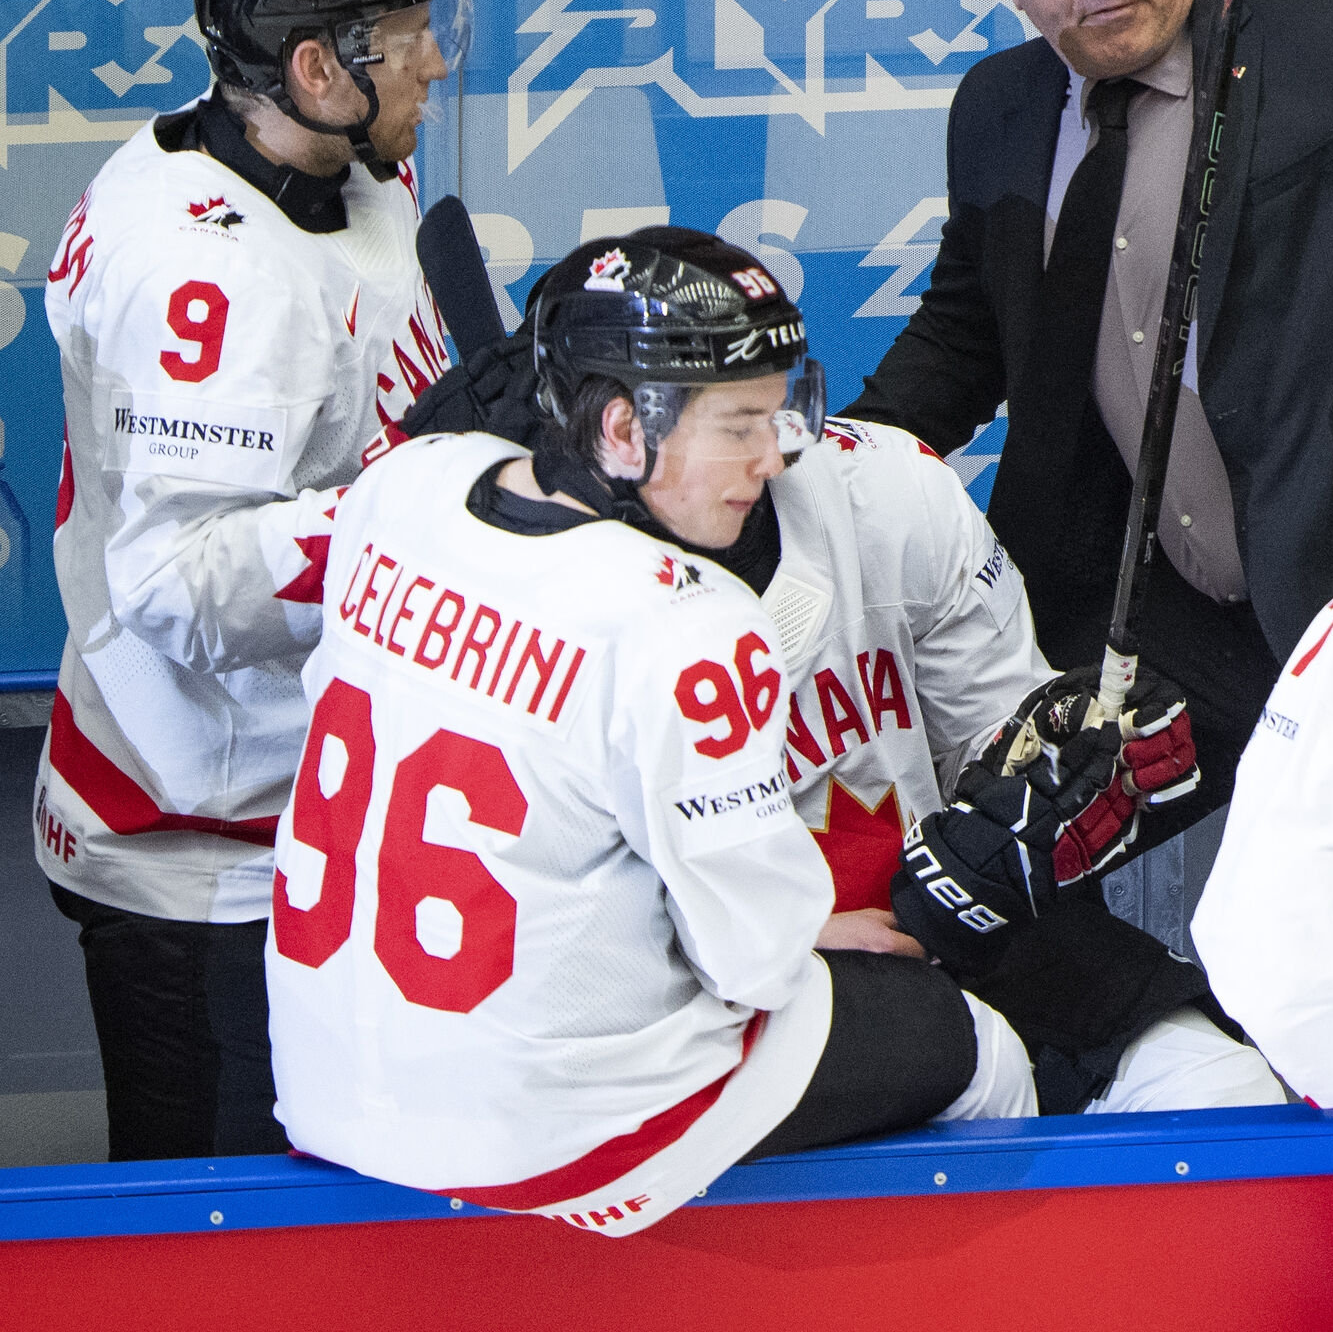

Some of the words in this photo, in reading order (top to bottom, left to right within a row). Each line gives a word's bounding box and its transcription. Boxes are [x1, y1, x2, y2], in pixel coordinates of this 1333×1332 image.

[178, 225, 239, 242] CANADA
[731, 267, 777, 300] 96
[158, 279, 230, 384] 9
[114, 407, 275, 452] WESTMINSTER
[149, 441, 200, 461] GROUP
[339, 542, 587, 724] CELEBRINI
[673, 630, 782, 760] 96
[272, 676, 529, 1014] 96
